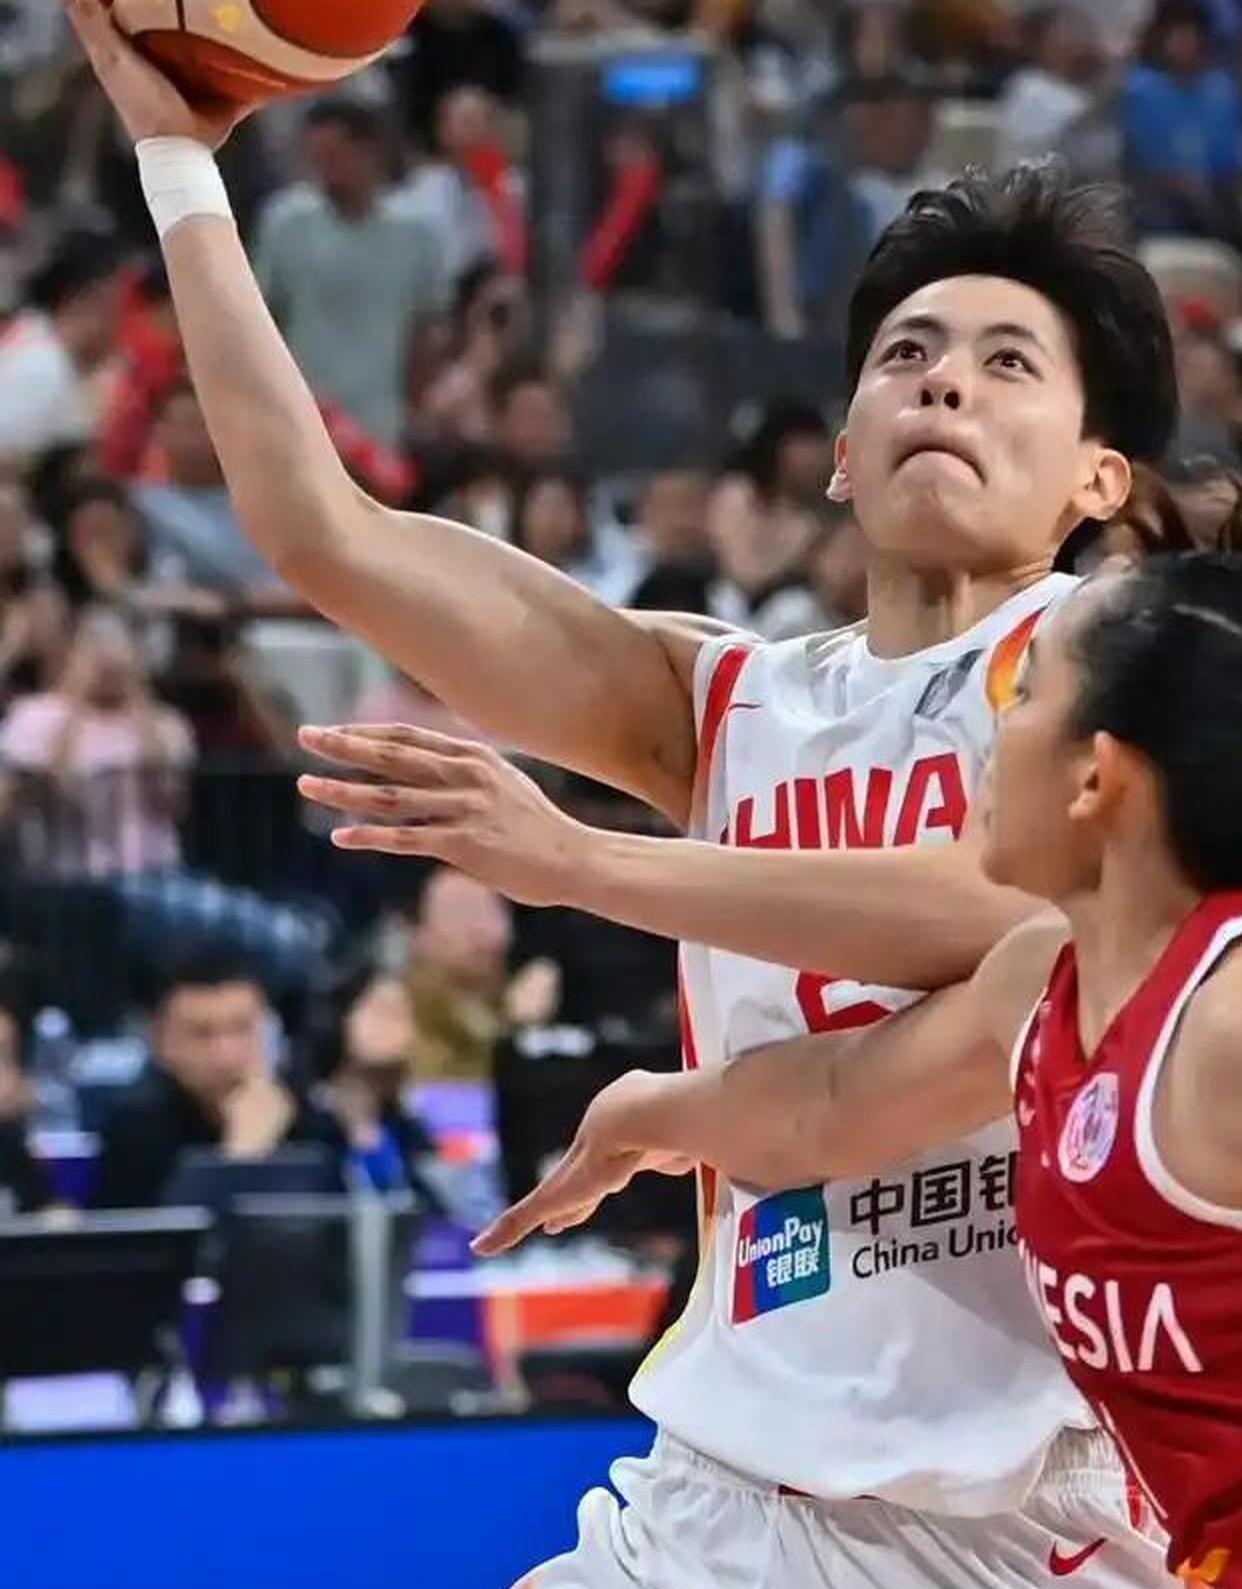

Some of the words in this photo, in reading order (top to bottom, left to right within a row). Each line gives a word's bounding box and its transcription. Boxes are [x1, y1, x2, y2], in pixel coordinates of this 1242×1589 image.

[720, 752, 968, 849] HINA
[738, 1216, 824, 1268] UnionPay
[852, 1240, 938, 1279] China
[767, 1248, 820, 1287] 银联
